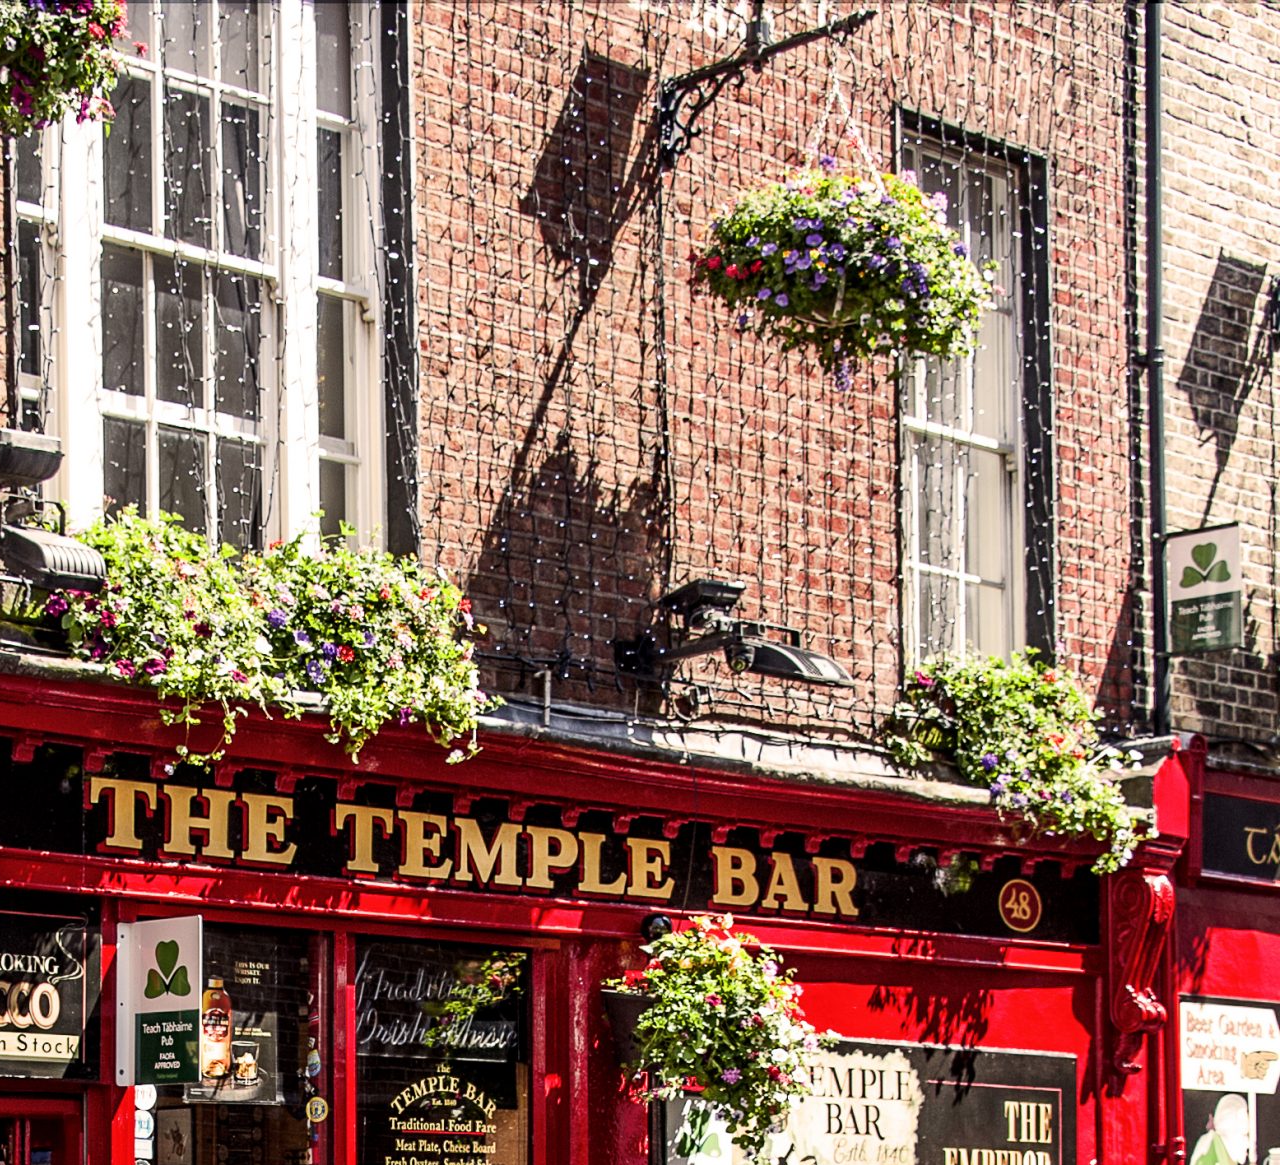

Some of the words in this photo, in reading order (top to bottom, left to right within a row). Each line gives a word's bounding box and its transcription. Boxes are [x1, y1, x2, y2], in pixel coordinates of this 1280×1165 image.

[90, 777, 298, 866] THE
[334, 803, 676, 899] TEMPLE
[712, 845, 859, 917] BAR
[1005, 888, 1031, 920] 48
[142, 1022, 161, 1034] Teach
[1186, 1010, 1213, 1034] Beer
[1219, 1013, 1263, 1038] Garden
[16, 1033, 79, 1056] Stock
[161, 1035, 174, 1046] Pub
[1186, 1037, 1237, 1065] Smoking
[809, 1065, 914, 1102] EMPLE
[1196, 1065, 1225, 1086] Area
[390, 1075, 460, 1115] TEMPLE
[465, 1081, 497, 1119] BAR
[388, 1116, 445, 1131] Traditional
[448, 1119, 472, 1132] Food
[476, 1120, 497, 1134] Fare
[825, 1102, 886, 1141] BAR
[1003, 1100, 1053, 1144] THE
[395, 1139, 416, 1152] Meat
[418, 1139, 441, 1154] Plate,
[443, 1140, 470, 1153] Cheese
[472, 1141, 496, 1154] Board
